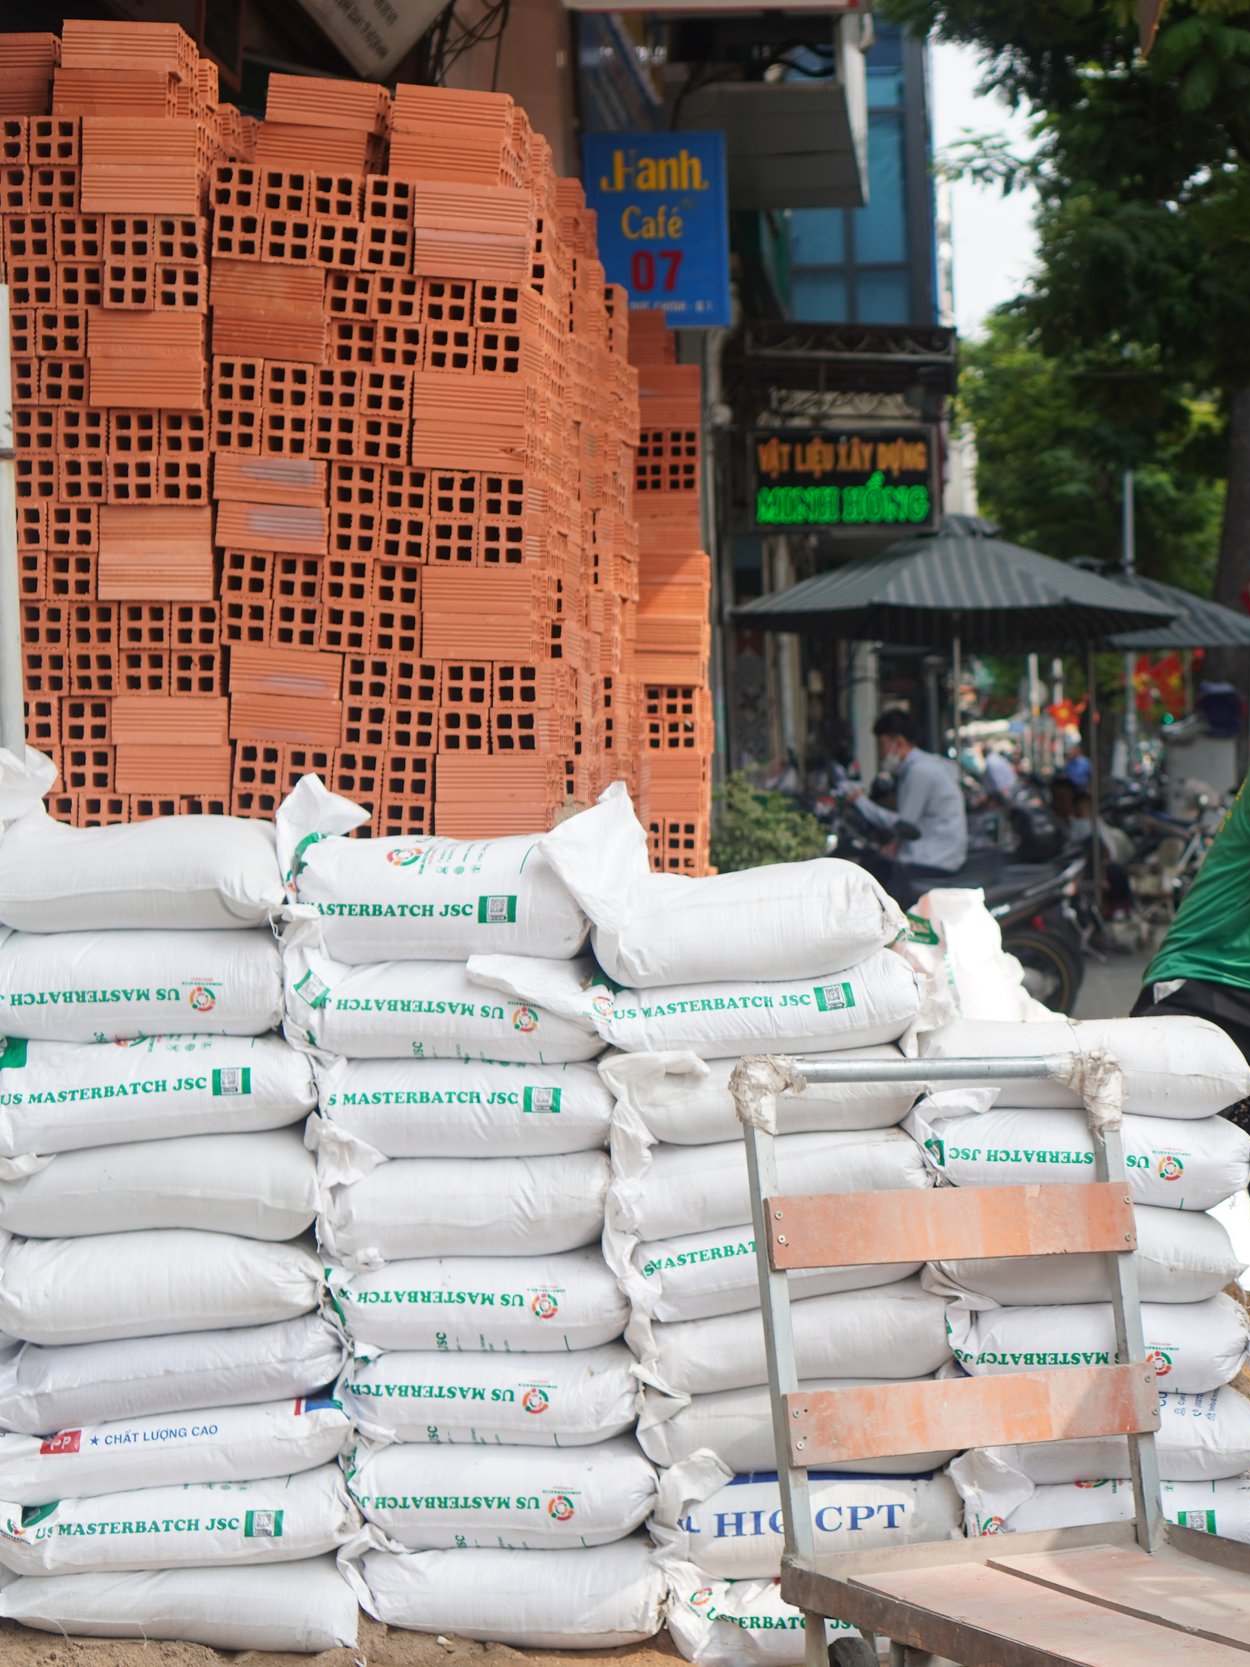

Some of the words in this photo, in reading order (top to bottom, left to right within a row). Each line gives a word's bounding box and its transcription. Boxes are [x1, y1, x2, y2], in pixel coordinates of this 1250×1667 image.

[621, 205, 683, 239] Café
[631, 251, 683, 292] 07
[309, 902, 434, 917] ASTERBATCH
[439, 903, 473, 917] JSC
[10, 988, 150, 1007] MASTERBATCH
[155, 987, 181, 1001] US
[335, 998, 475, 1017] MASTERBATCH
[480, 1006, 504, 1020] US
[613, 1008, 637, 1020] US
[779, 994, 811, 1007] JSC
[28, 1079, 167, 1105] MASTERBATCH
[172, 1077, 207, 1091] JSC
[343, 1091, 481, 1105] MASTERBATCH
[487, 1092, 519, 1105] JSC
[949, 1147, 980, 1161] JSC
[986, 1149, 1095, 1165] STERBATCH
[1126, 1154, 1150, 1168] US
[649, 1240, 757, 1270] MASTERBAT
[357, 1289, 495, 1306] MASTERBATCH
[500, 1293, 524, 1307] US
[953, 1348, 973, 1364] JS
[976, 1351, 1109, 1366] MASTERBATCH
[491, 1388, 515, 1402] US
[104, 1428, 139, 1445] CHẤT
[143, 1427, 187, 1442] LƯỢNG
[192, 1424, 218, 1437] CAO
[375, 1496, 511, 1510] MASTERBATCH
[516, 1496, 540, 1510] US
[815, 1503, 905, 1532] CPT
[58, 1519, 200, 1536] MASTERBATCH
[205, 1517, 240, 1531] JSC
